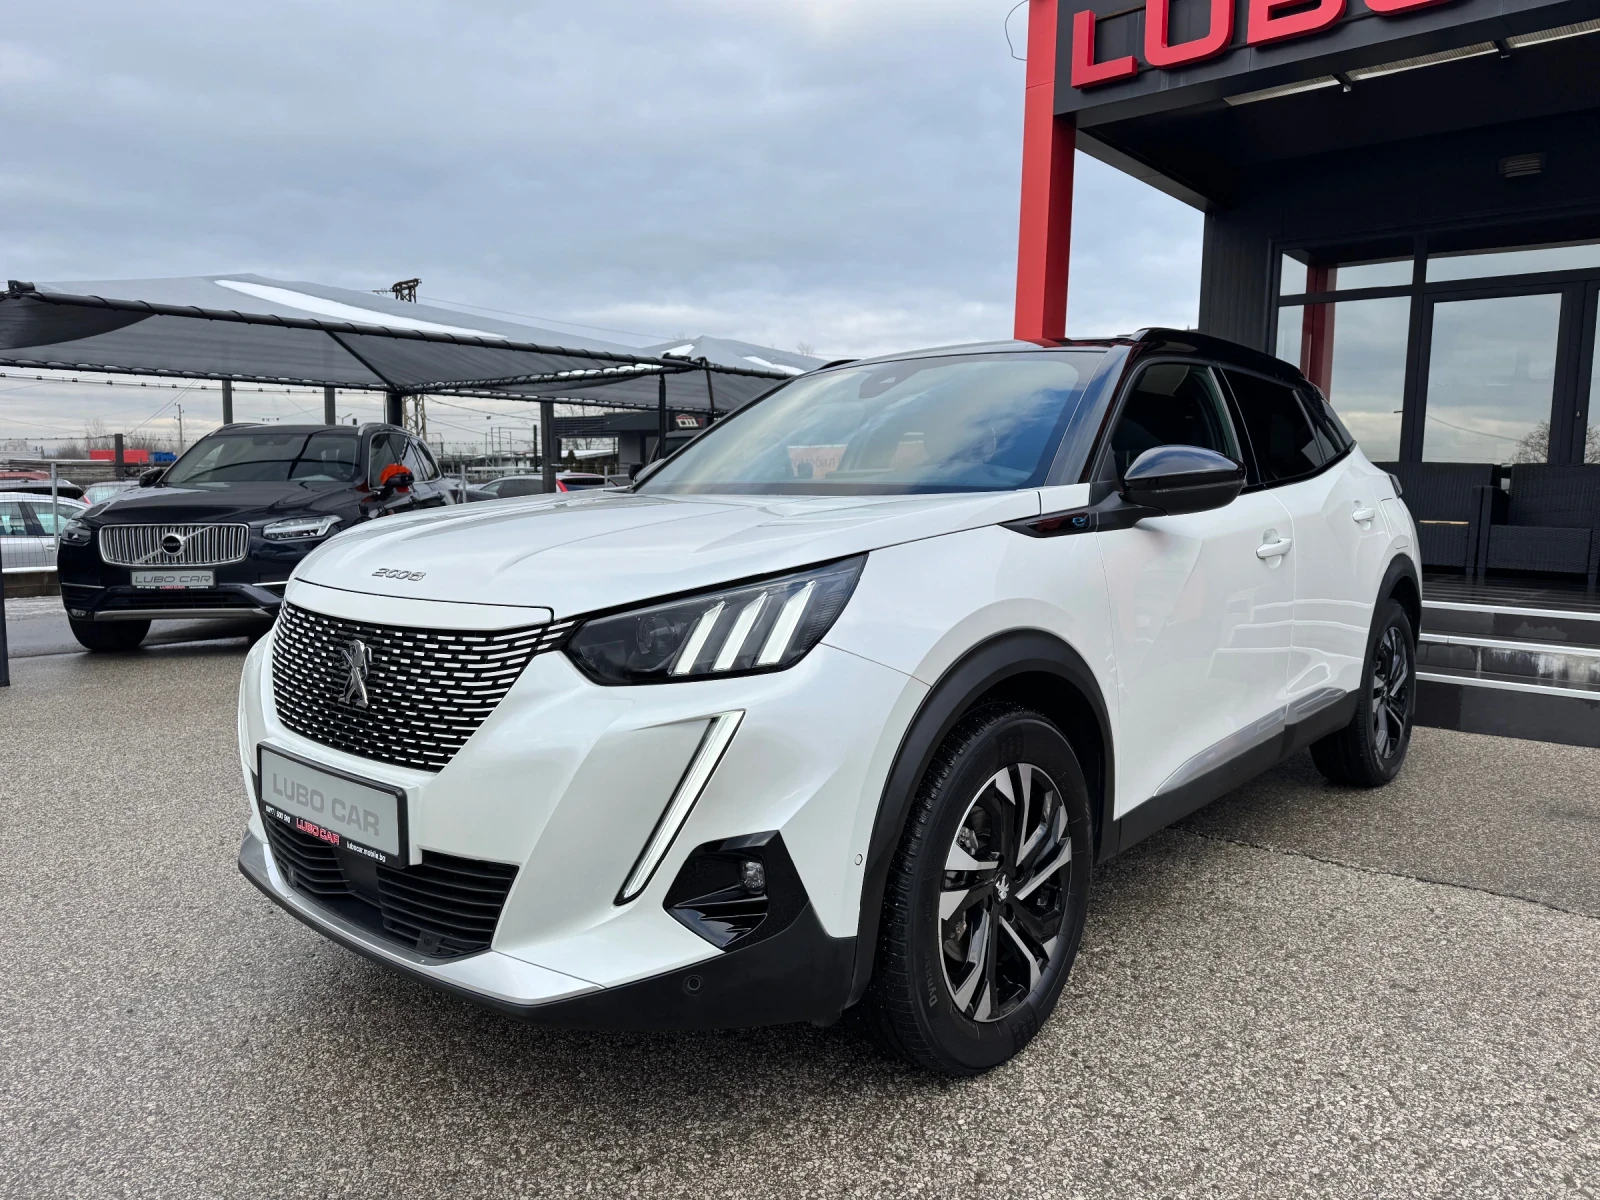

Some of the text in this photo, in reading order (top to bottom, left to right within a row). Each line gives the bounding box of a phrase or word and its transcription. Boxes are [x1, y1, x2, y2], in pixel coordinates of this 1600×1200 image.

[135, 575, 211, 583] LUBO CAR
[371, 568, 426, 581] 2008
[272, 772, 380, 837] LUBO CAR
[296, 817, 319, 837] LUBO
[320, 828, 339, 846] CAR
